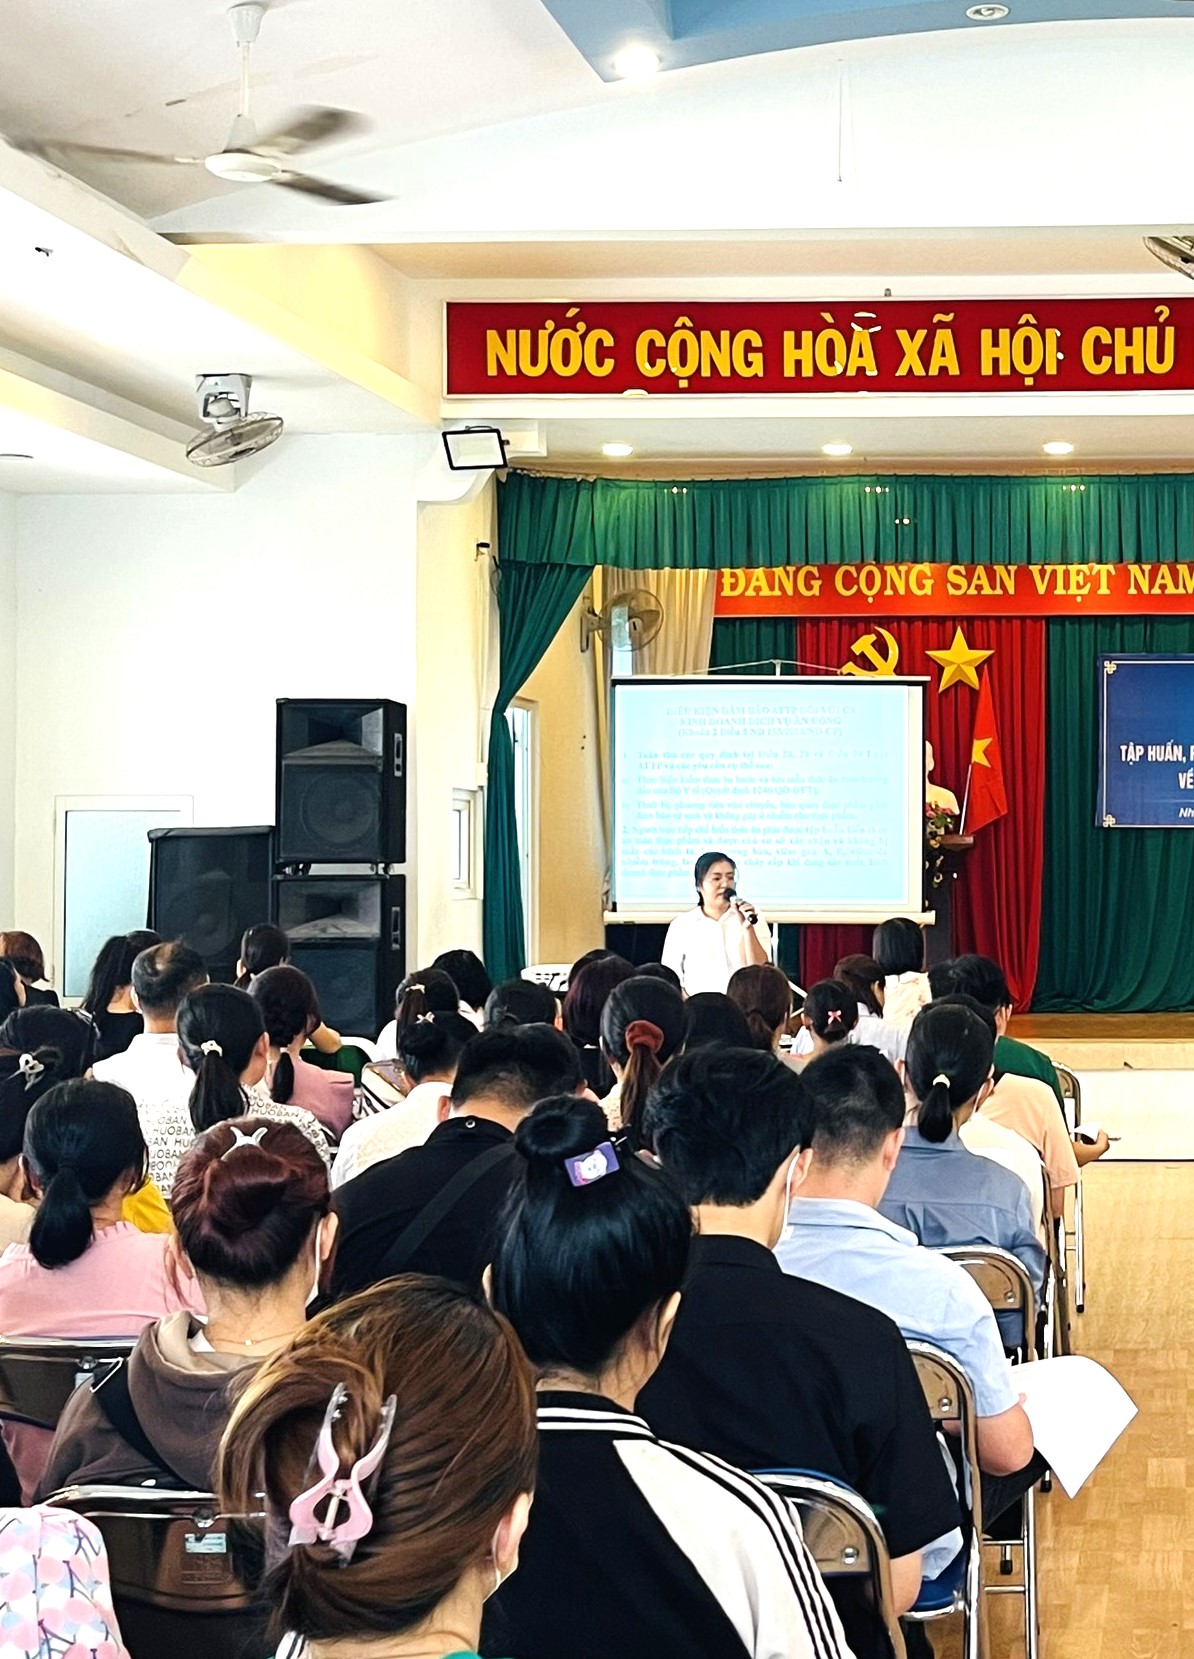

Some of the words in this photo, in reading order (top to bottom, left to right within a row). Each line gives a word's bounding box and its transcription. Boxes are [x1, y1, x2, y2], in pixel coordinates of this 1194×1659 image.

[487, 308, 614, 376] NƯỚC
[636, 317, 763, 388] CỘNG
[784, 312, 876, 377] HÒA
[896, 313, 959, 376] XÃ
[981, 314, 1057, 385] HỘI
[1082, 306, 1174, 374] CHỦ
[1120, 741, 1145, 766] TẬP
[1147, 739, 1187, 764] HUẤN,
